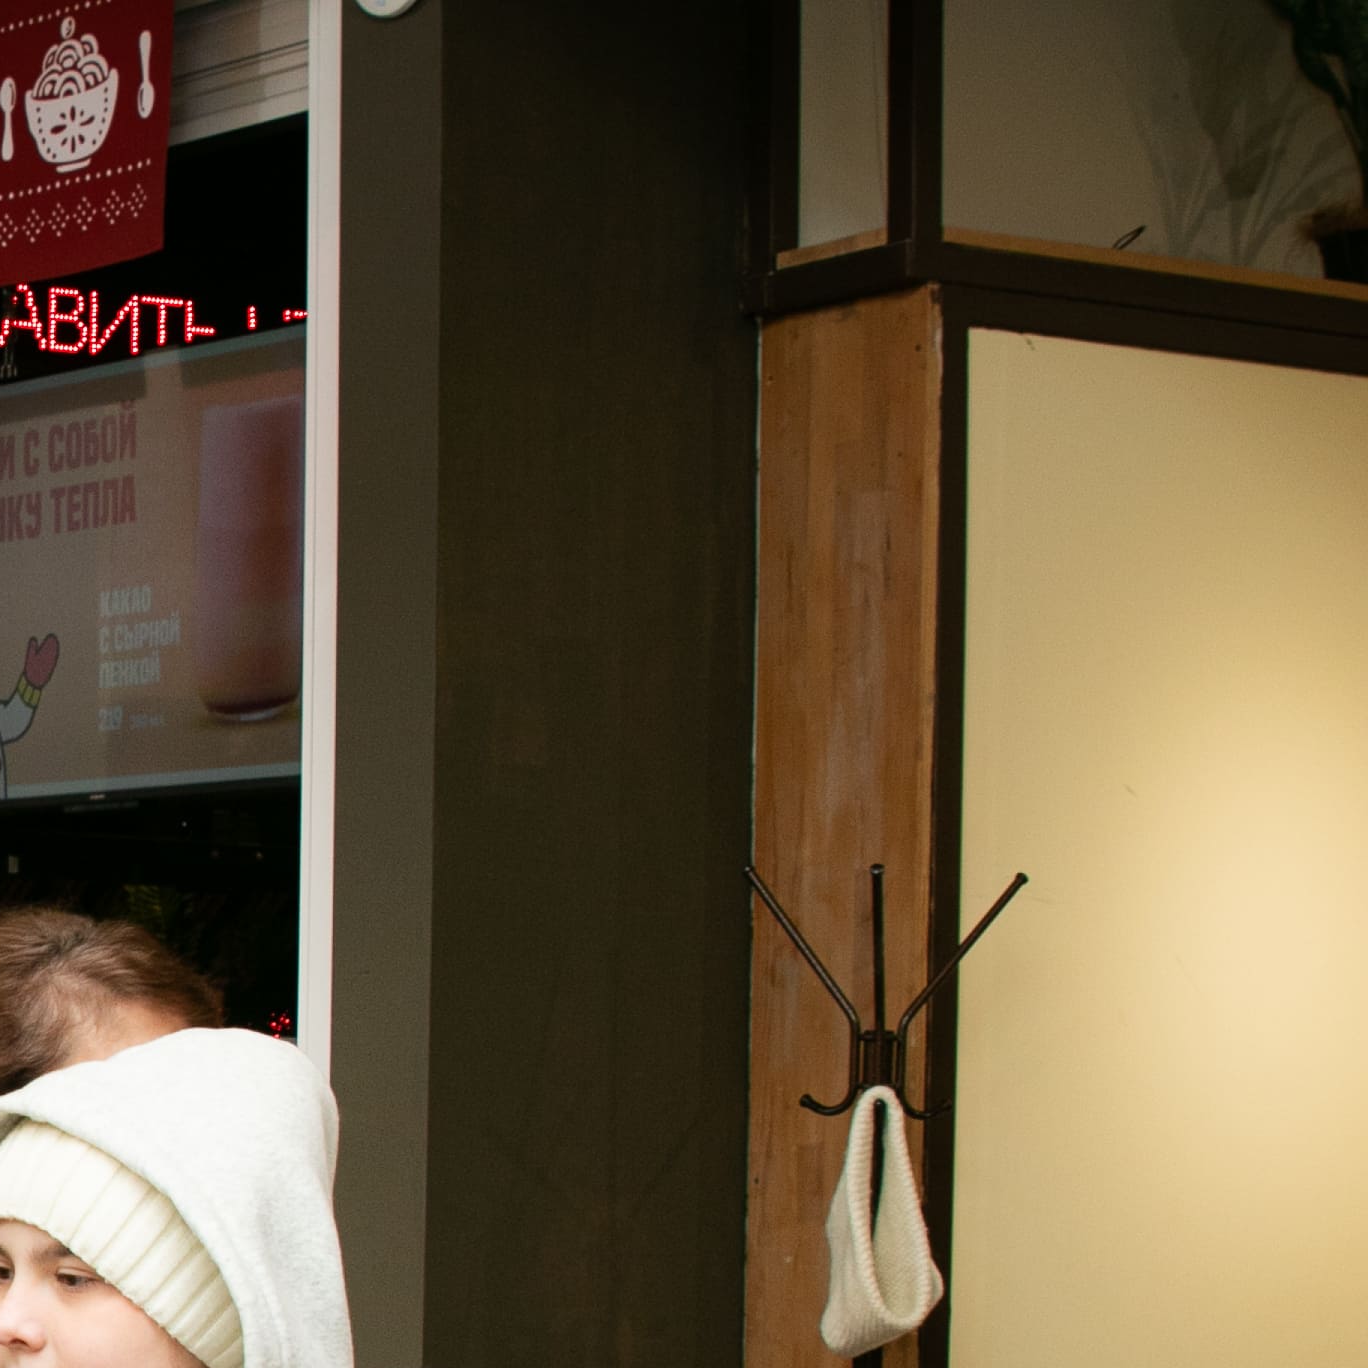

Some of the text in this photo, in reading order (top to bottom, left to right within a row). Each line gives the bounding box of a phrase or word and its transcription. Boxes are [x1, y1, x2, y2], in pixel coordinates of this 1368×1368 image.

[22, 426, 41, 478] С
[48, 399, 138, 472] СОБОЙ
[55, 474, 138, 533] ТЕПЛА
[99, 585, 153, 617] КАКАО
[113, 611, 181, 651] СЫРНОЙ
[98, 650, 161, 689] ПЕНКОЙ
